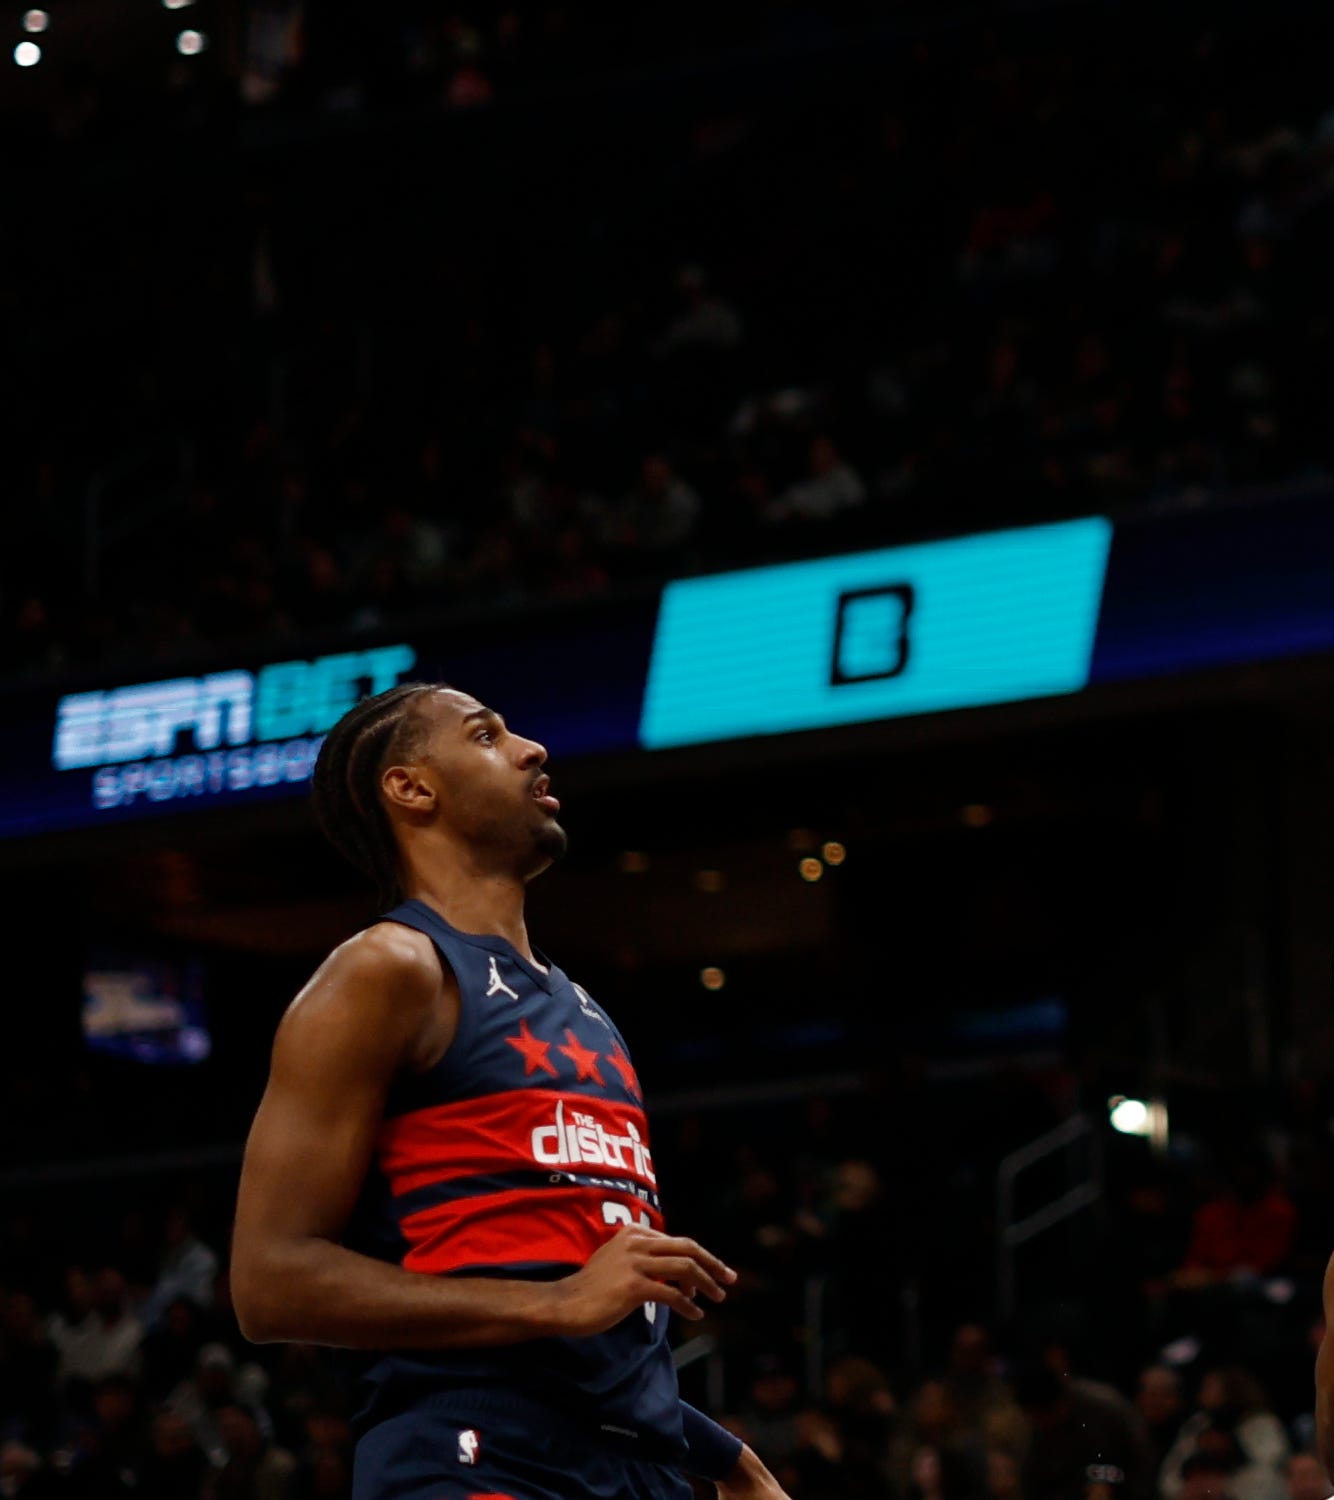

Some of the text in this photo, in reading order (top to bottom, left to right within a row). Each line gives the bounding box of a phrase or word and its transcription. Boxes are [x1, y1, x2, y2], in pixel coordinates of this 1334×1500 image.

[829, 583, 914, 687] B
[53, 644, 417, 771] ESPN BET
[531, 1099, 657, 1184] distric
[571, 1111, 595, 1128] THE
